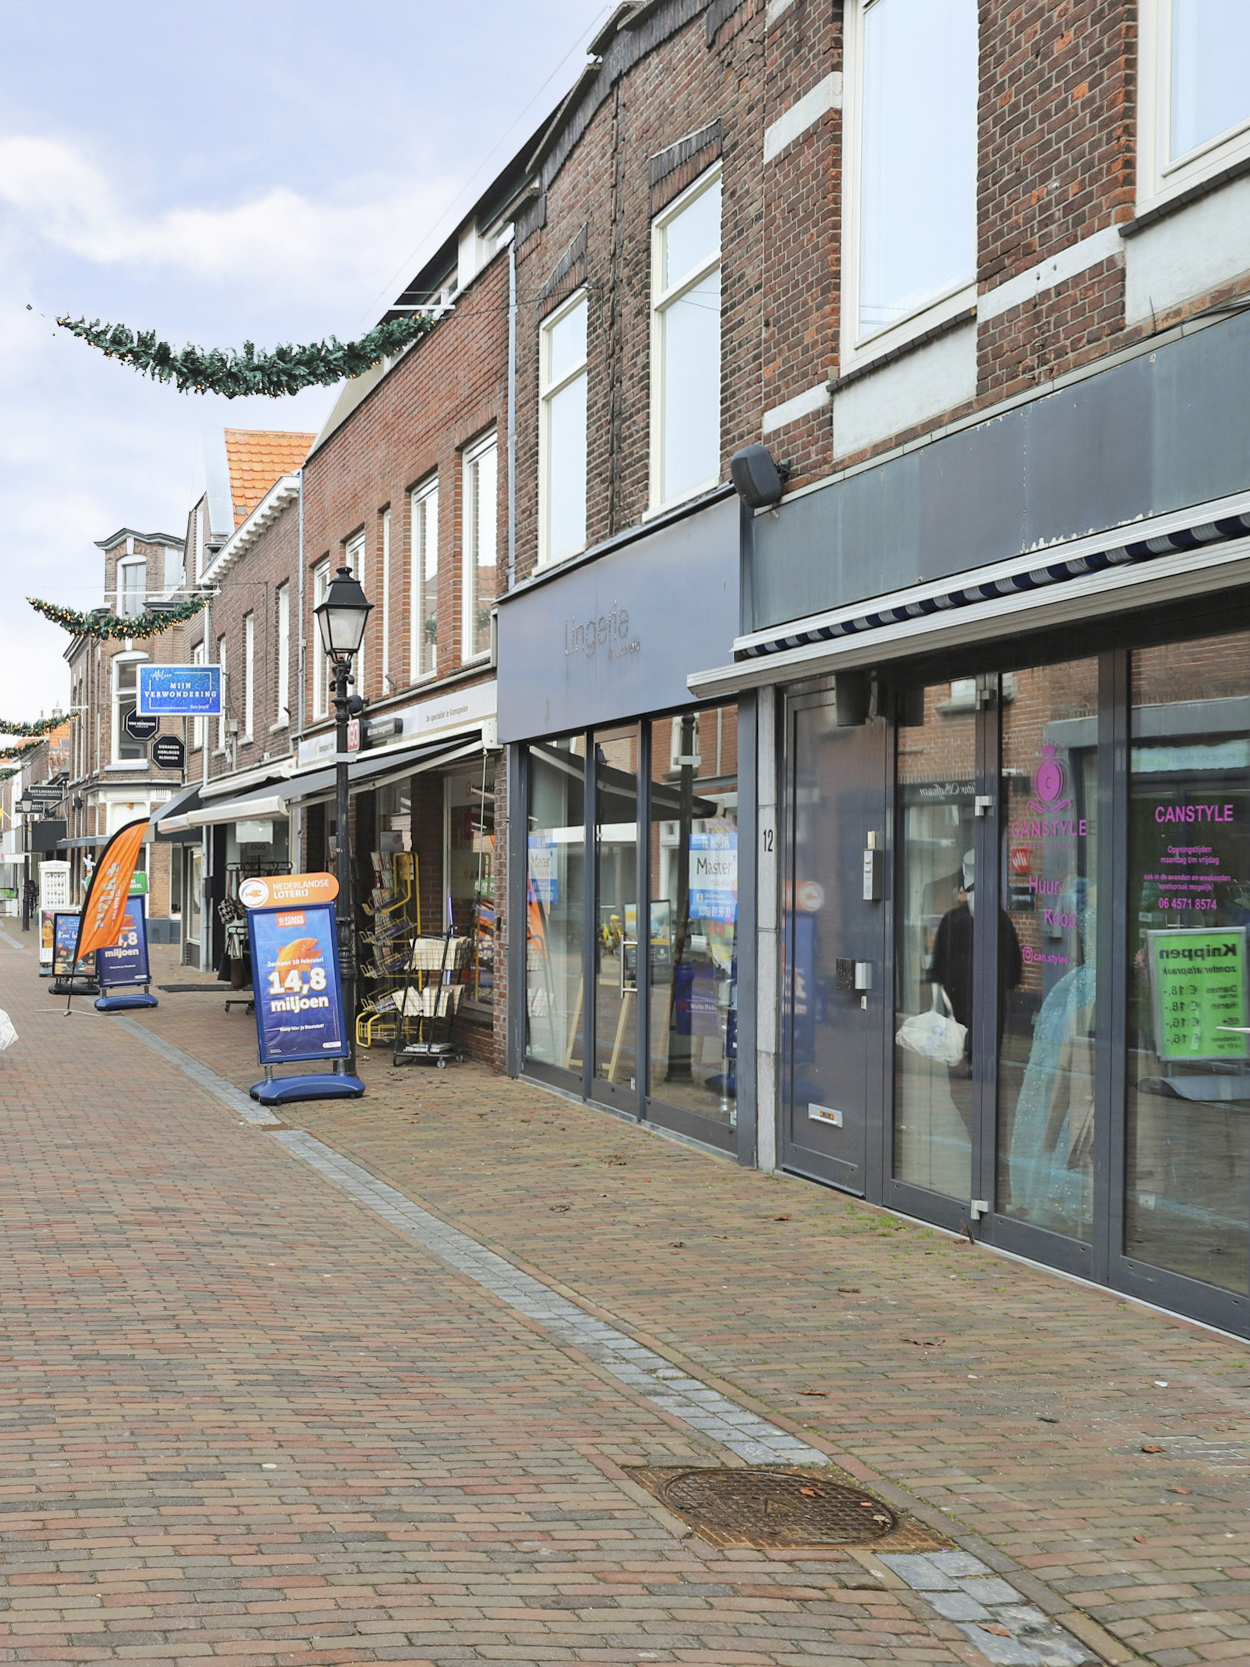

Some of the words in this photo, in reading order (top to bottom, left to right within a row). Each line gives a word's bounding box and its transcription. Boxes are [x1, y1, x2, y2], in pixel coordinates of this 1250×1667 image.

[144, 690, 217, 698] VERWONDERING
[1155, 805, 1234, 823] CANSTYLE
[1012, 820, 1087, 837] CANSTYLE
[763, 829, 773, 852] 12
[696, 857, 732, 875] Master
[272, 878, 330, 891] NEDERLANDSE
[1028, 875, 1061, 895] Huur
[273, 889, 310, 900] LOTERIJ
[1158, 897, 1169, 908] 06
[1171, 898, 1192, 909] 4571
[1195, 899, 1217, 910] 8574
[1044, 908, 1077, 932] Koop
[105, 948, 139, 958] miljoen
[268, 967, 327, 996] 14,8
[271, 994, 329, 1014] miljoen
